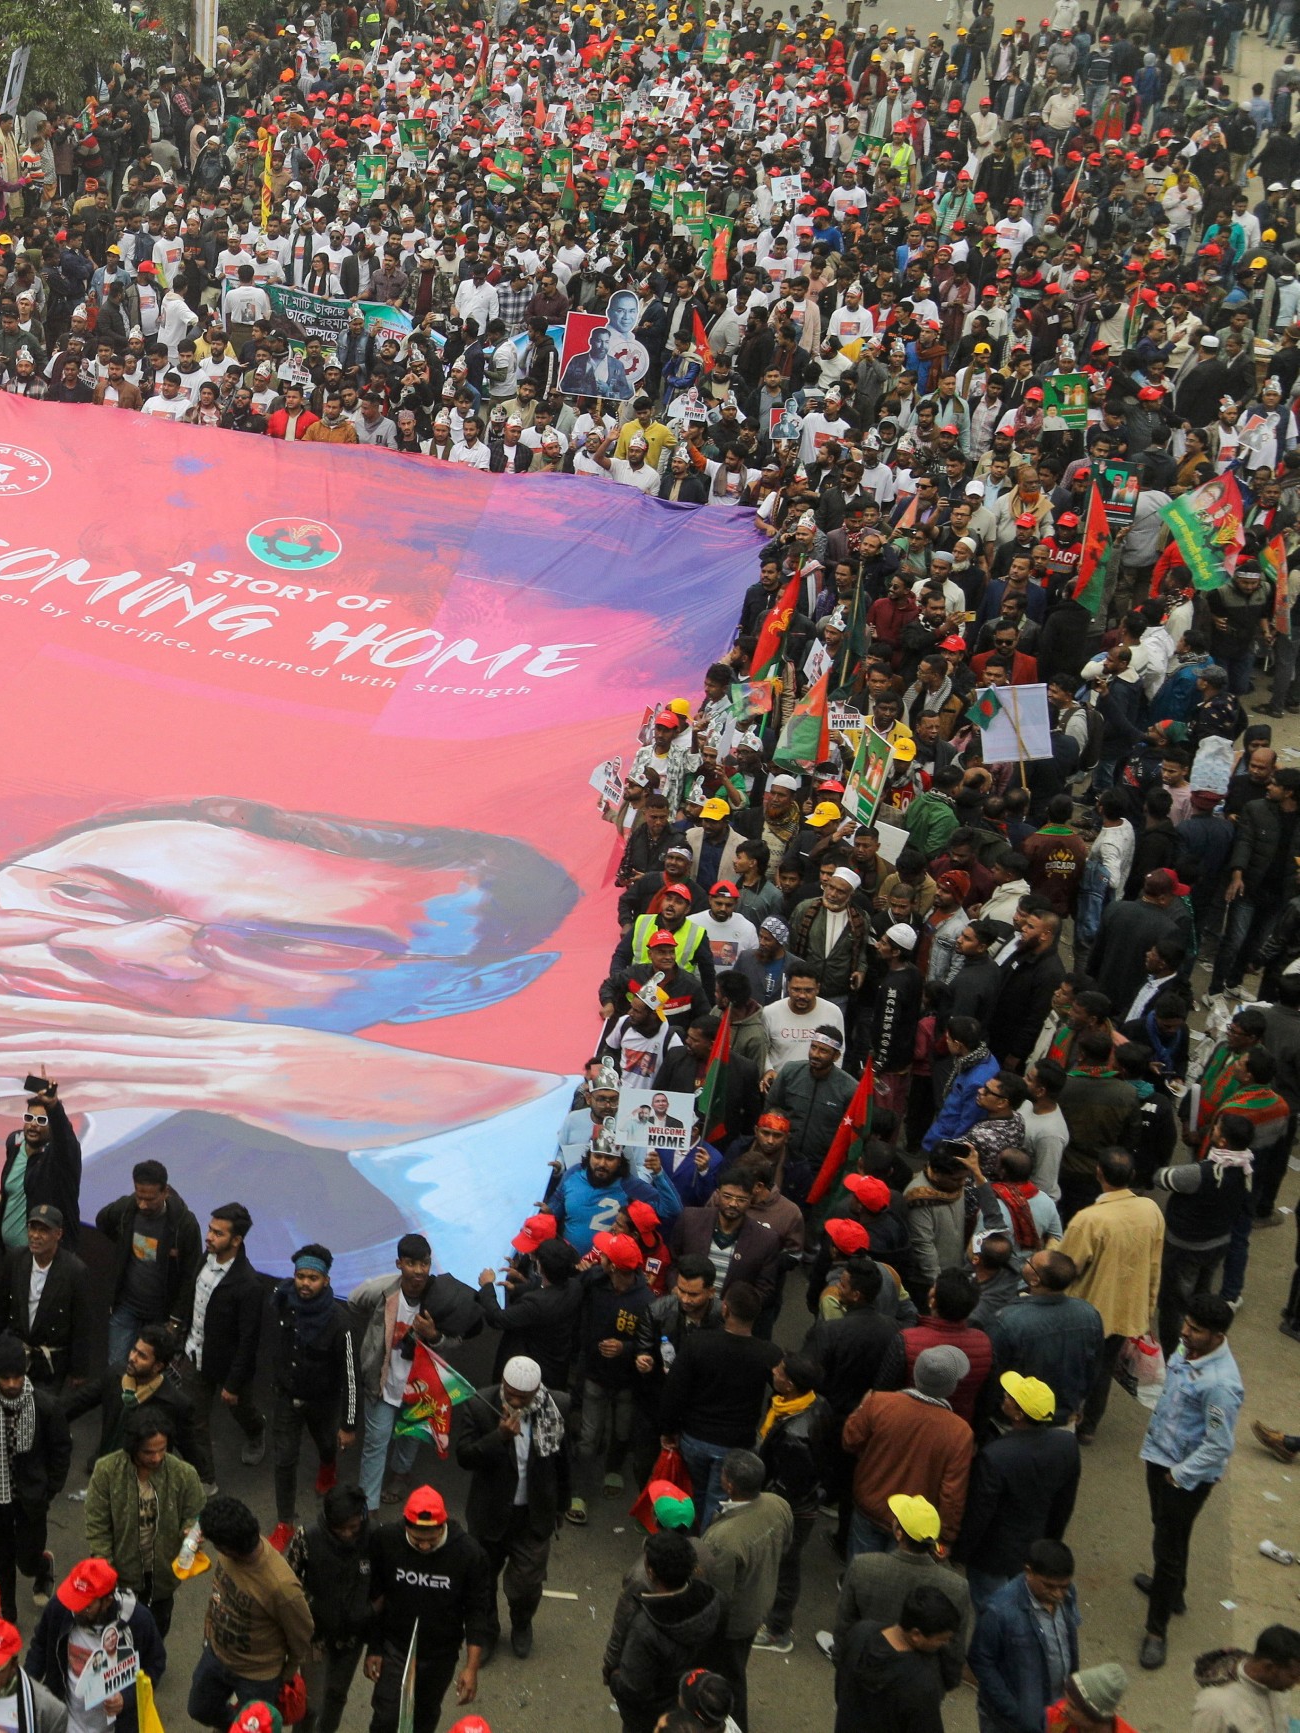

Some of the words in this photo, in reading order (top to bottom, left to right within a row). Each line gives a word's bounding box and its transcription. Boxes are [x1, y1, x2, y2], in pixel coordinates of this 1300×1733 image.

[292, 375, 309, 385] HOME
[684, 412, 705, 421] HOME
[167, 561, 197, 577] A
[205, 570, 332, 603] STORY
[336, 594, 392, 613] OF
[39, 601, 71, 619] by
[81, 614, 197, 654] sacrifice,
[209, 647, 330, 678] returned
[340, 672, 397, 690] with
[413, 682, 532, 700] strength
[306, 621, 598, 681] HOME
[831, 719, 861, 729] HOME
[603, 785, 620, 803] HOME
[648, 1126, 686, 1136] WELCOME
[648, 1135, 685, 1148] HOME
[588, 1198, 621, 1232] 2
[396, 1568, 451, 1590] POKER
[103, 1655, 138, 1681] WELCOME
[104, 1666, 137, 1695] HOME
